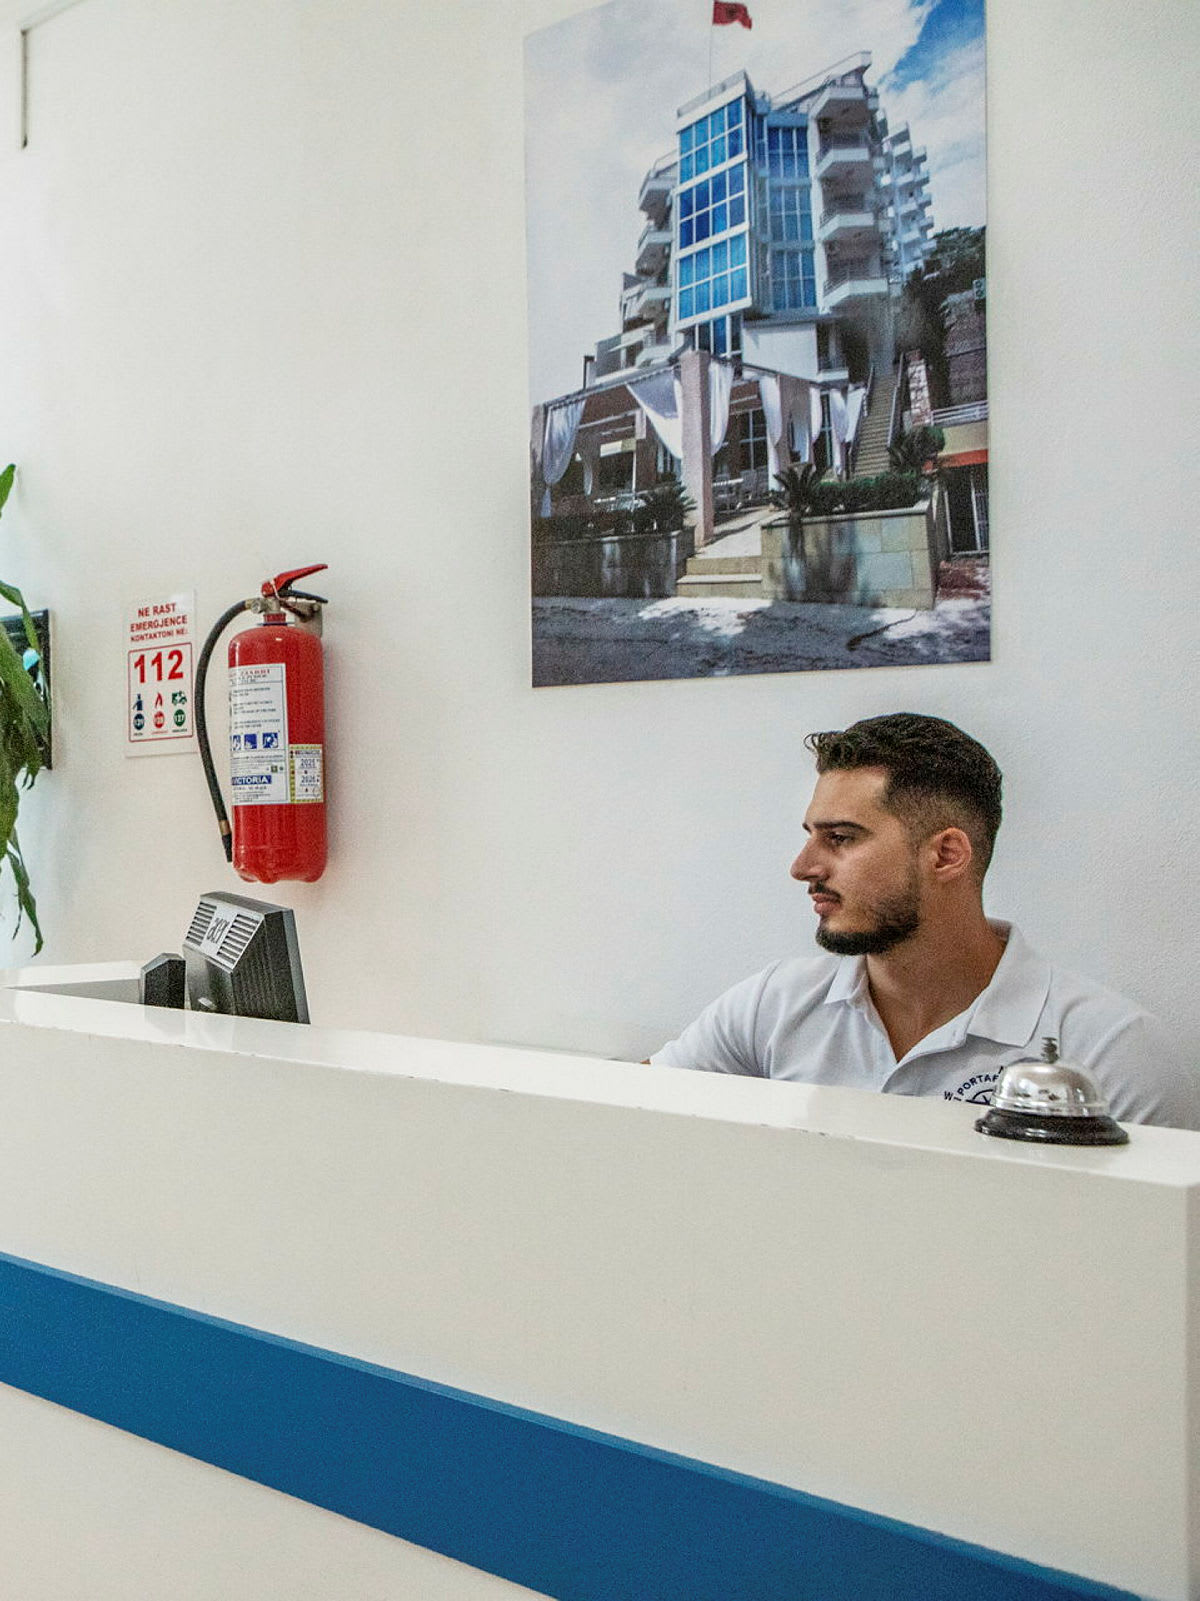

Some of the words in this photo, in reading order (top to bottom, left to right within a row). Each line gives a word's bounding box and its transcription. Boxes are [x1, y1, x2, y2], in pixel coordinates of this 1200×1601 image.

[138, 606, 150, 618] NE
[153, 603, 177, 616] RAST
[134, 649, 184, 683] 112
[957, 1074, 999, 1096] PORTAF
